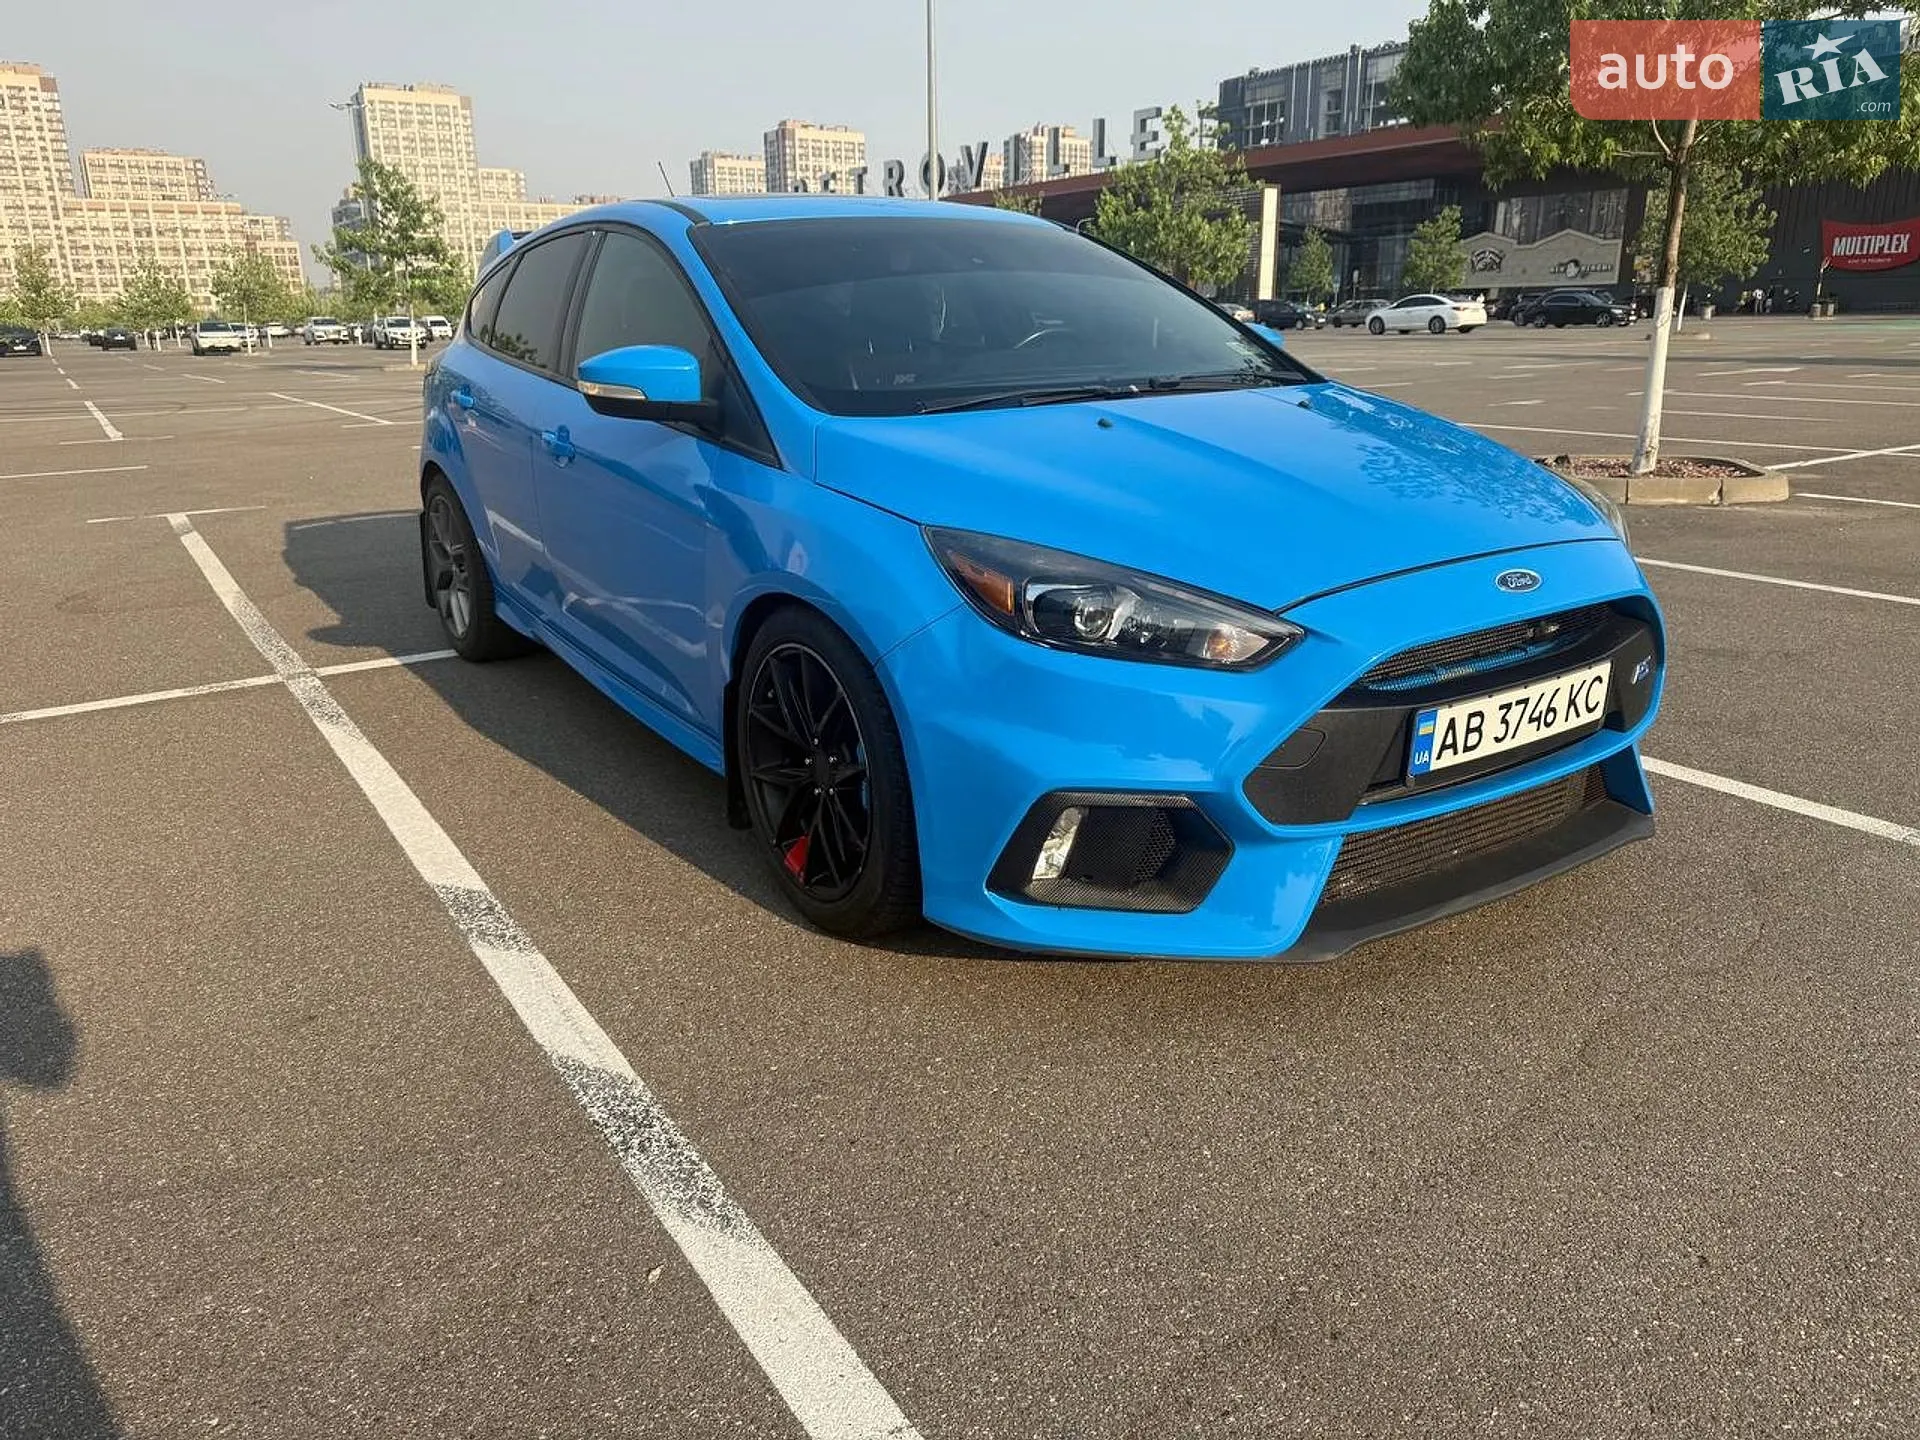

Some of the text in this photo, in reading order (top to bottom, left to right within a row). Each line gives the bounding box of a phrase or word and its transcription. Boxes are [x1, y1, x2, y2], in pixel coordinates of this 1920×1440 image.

[1832, 232, 1911, 256] MULTIPLEX
[1436, 675, 1603, 761] AB 3746 KC
[1414, 753, 1430, 765] UA
